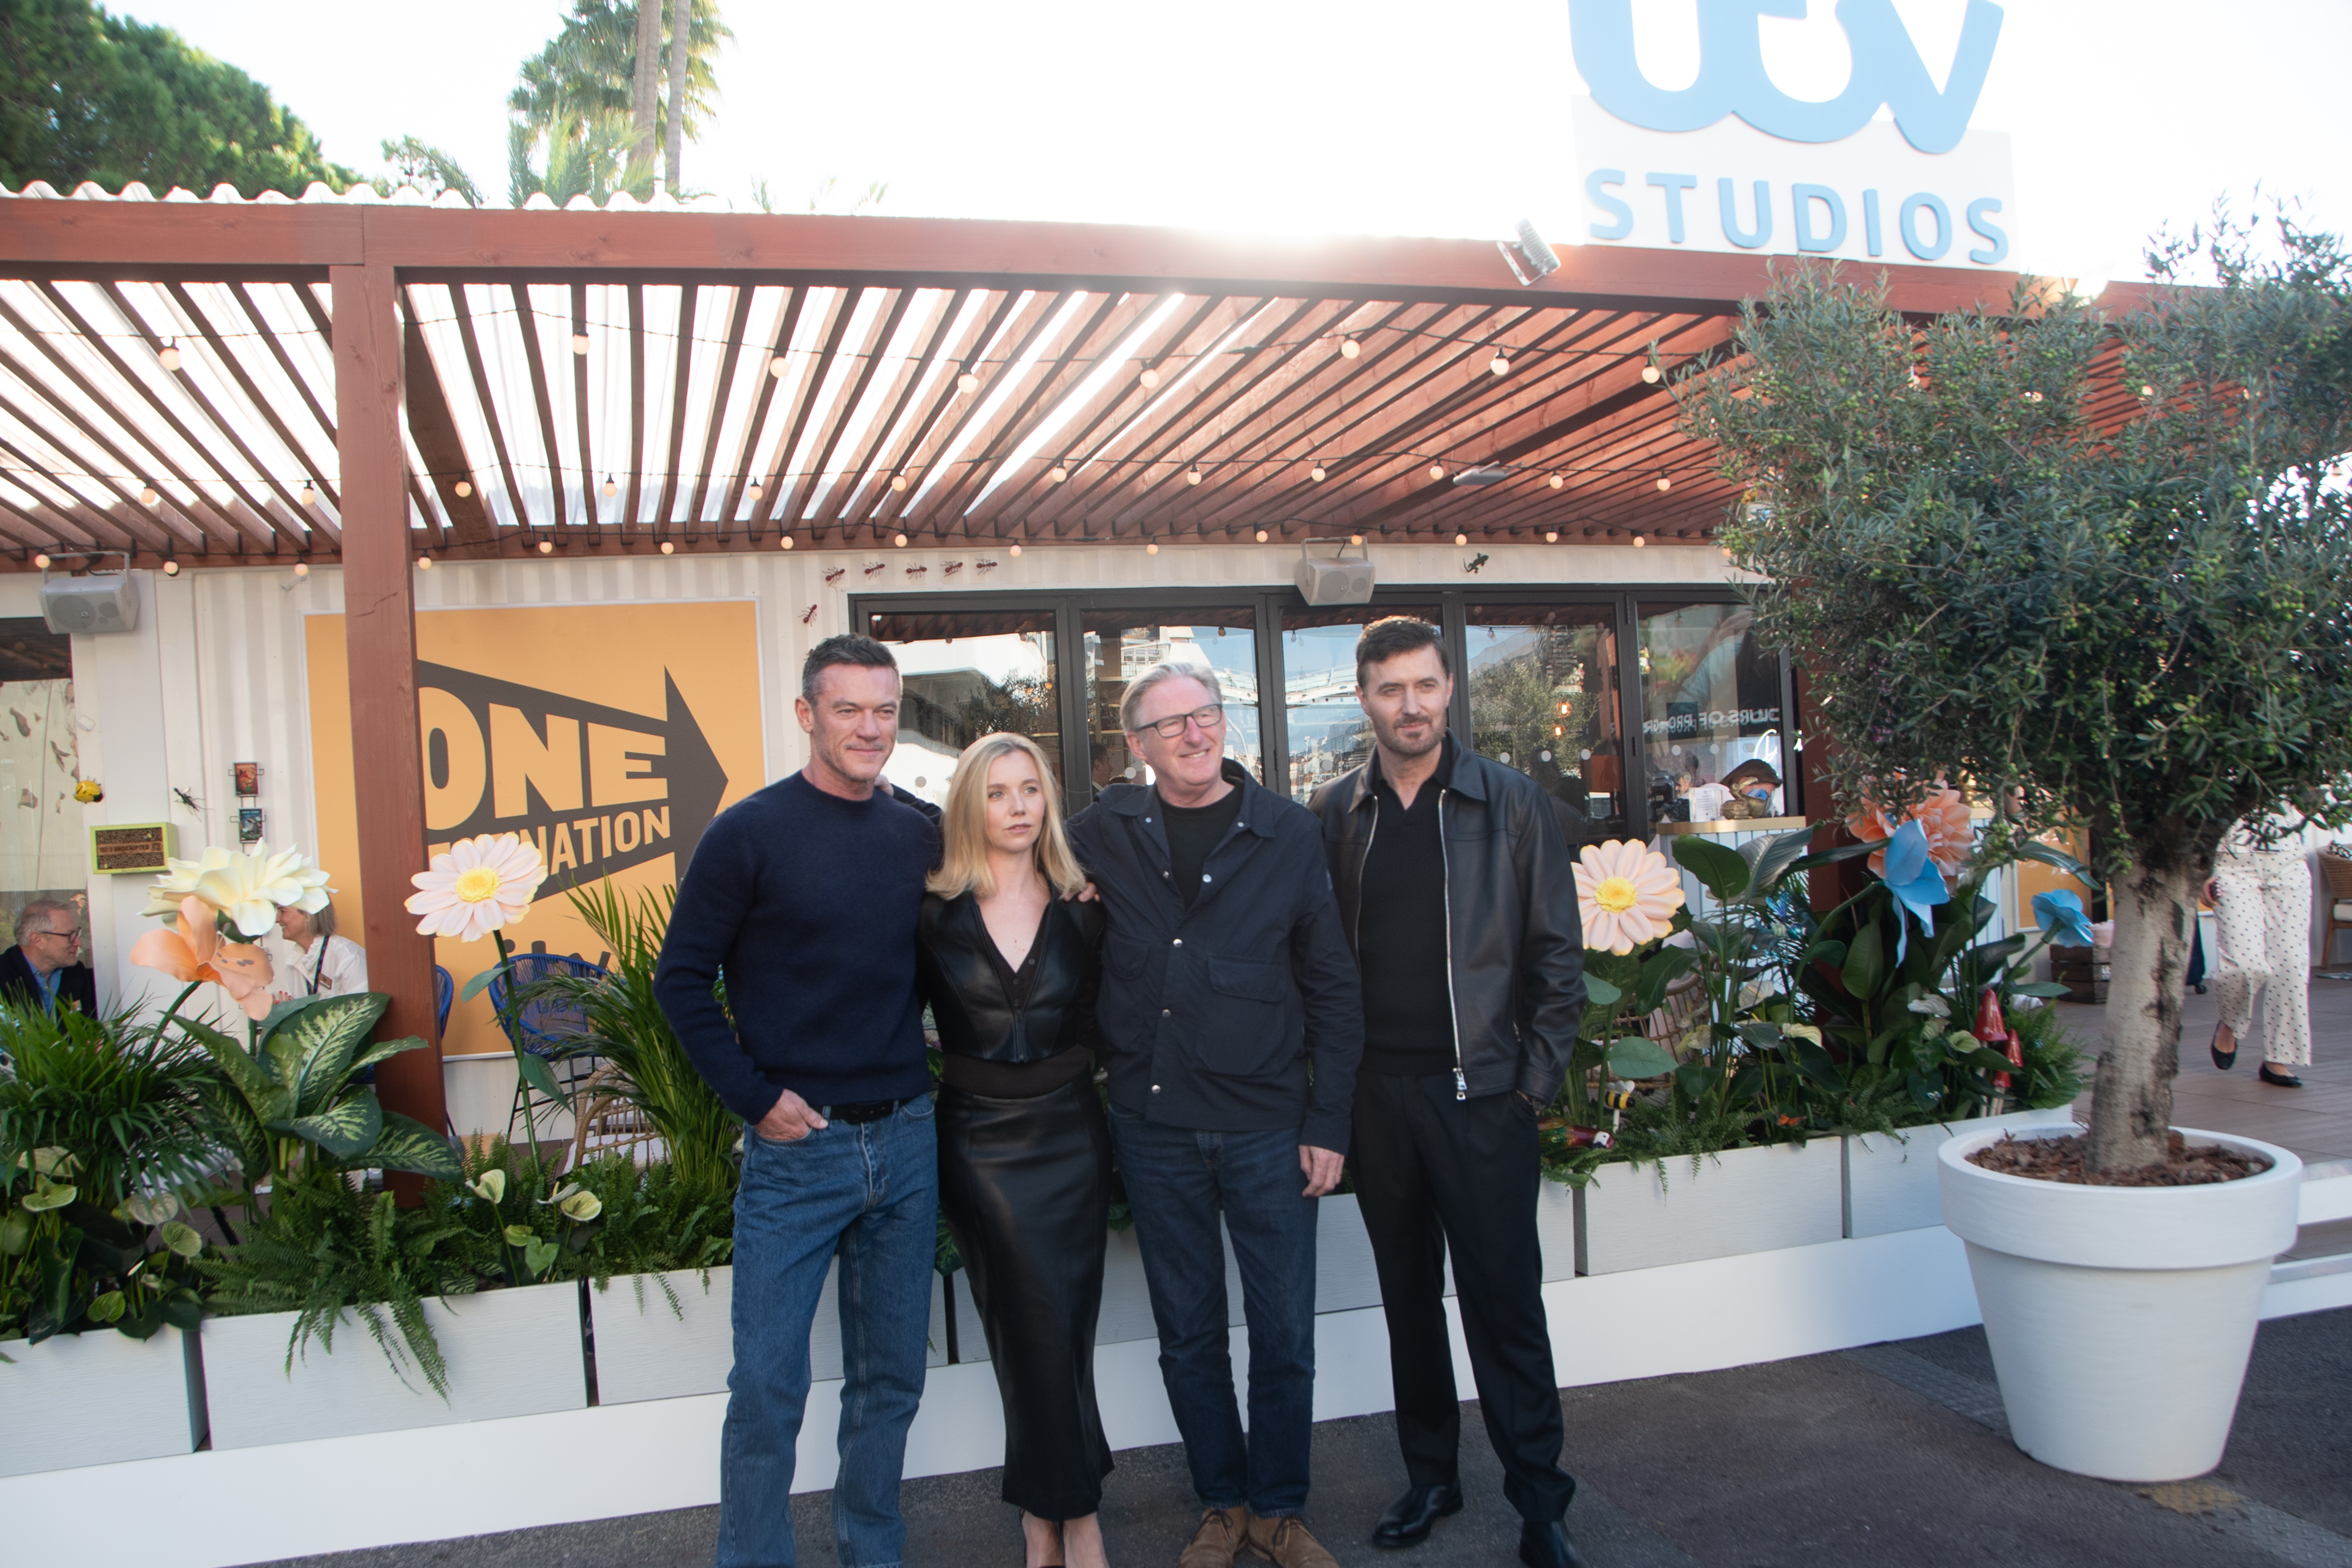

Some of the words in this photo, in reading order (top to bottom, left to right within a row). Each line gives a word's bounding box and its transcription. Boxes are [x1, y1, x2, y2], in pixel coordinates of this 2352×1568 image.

[1584, 168, 2009, 264] STUDIOS
[418, 686, 668, 830] ONE
[428, 806, 670, 876] NATION
